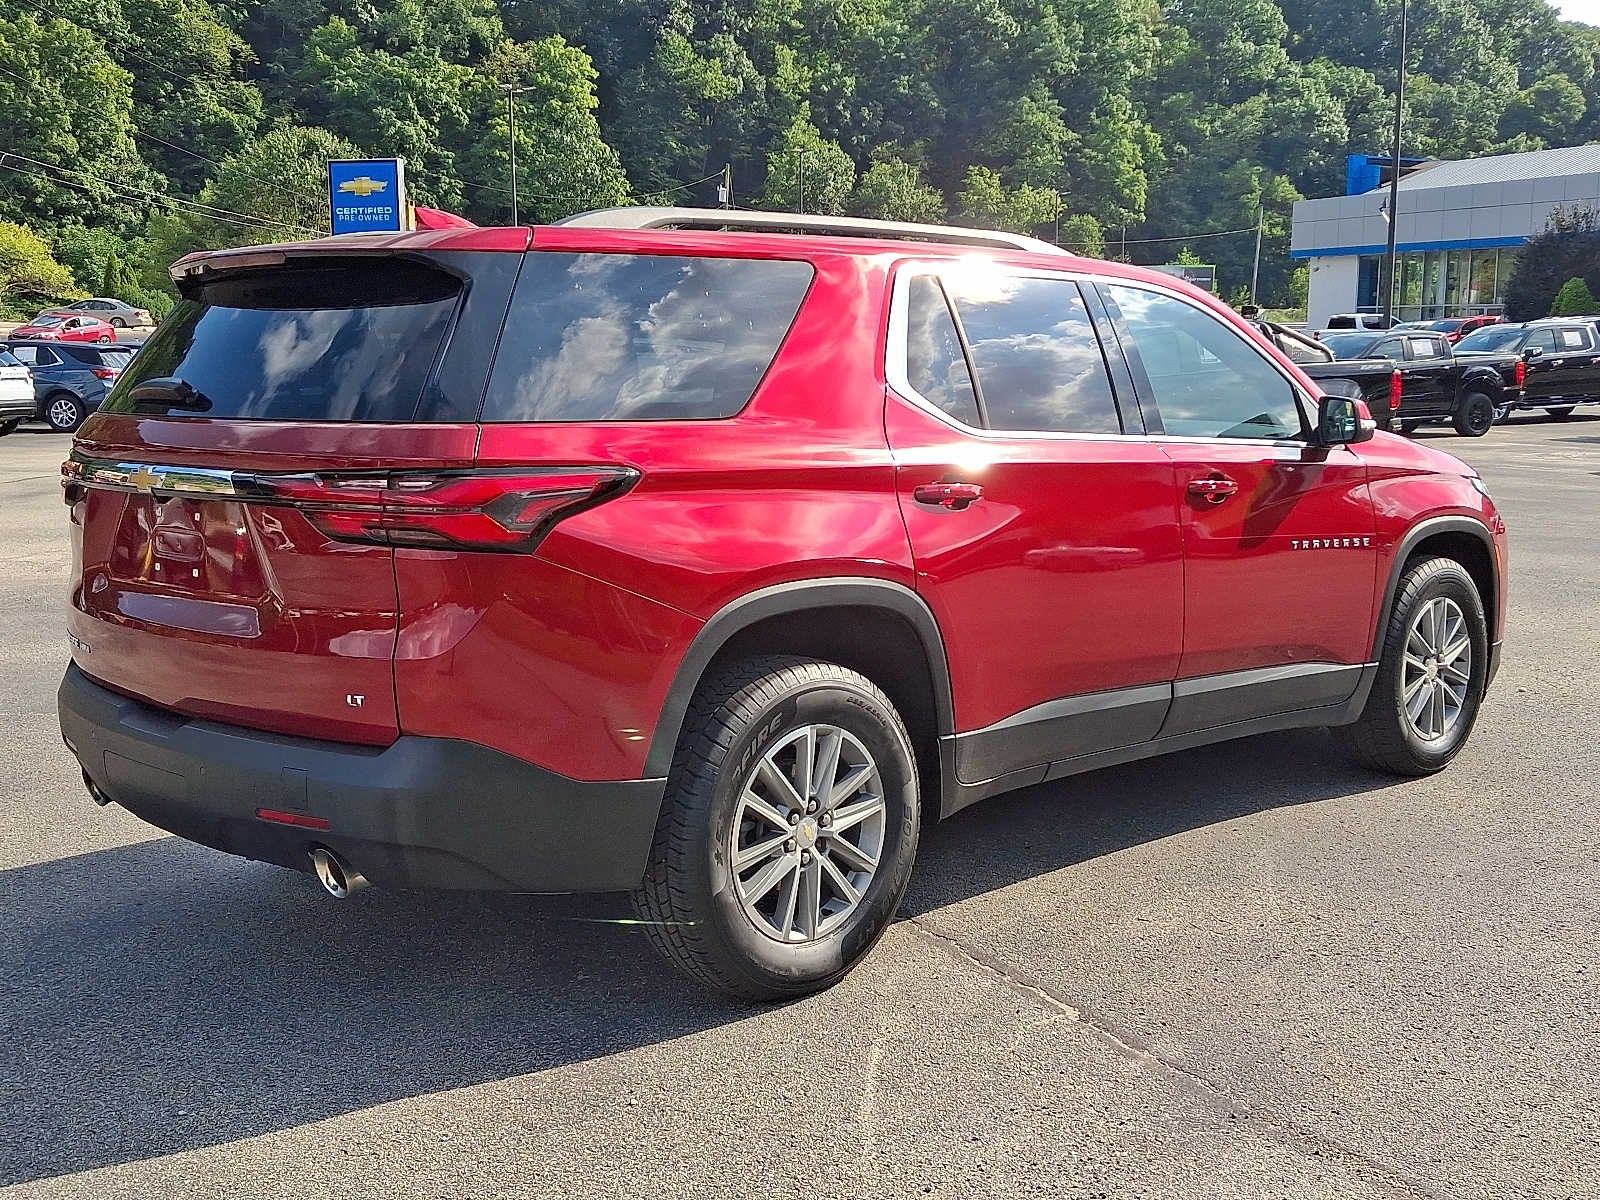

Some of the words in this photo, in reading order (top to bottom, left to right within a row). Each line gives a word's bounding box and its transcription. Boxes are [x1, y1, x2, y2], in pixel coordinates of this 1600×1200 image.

[336, 206, 392, 215] CERTIFIED
[1291, 537, 1370, 549] TRAVERSE
[346, 694, 365, 707] LT
